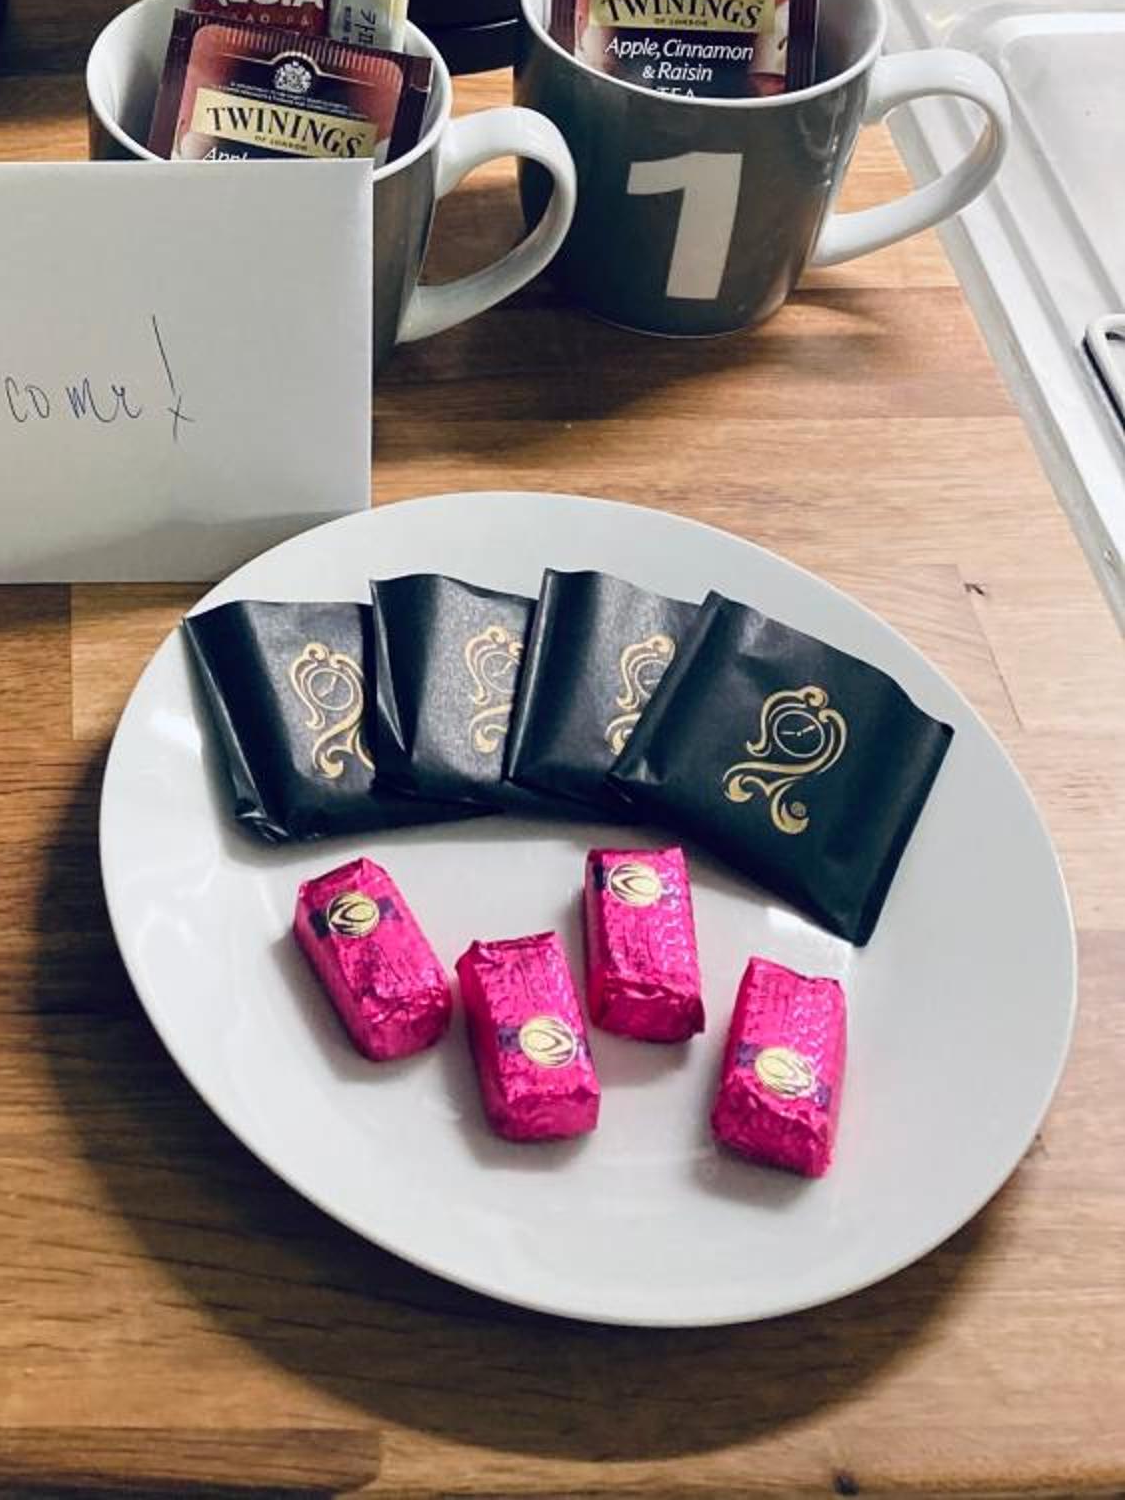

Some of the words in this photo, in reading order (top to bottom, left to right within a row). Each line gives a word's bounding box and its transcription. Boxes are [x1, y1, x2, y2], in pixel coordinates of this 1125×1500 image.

[605, 36, 661, 60] Apple,
[663, 38, 754, 61] Cinnamon
[642, 65, 654, 79] &
[657, 61, 714, 82] Raisin
[207, 107, 363, 158] TWININGS
[627, 151, 743, 299] 1
